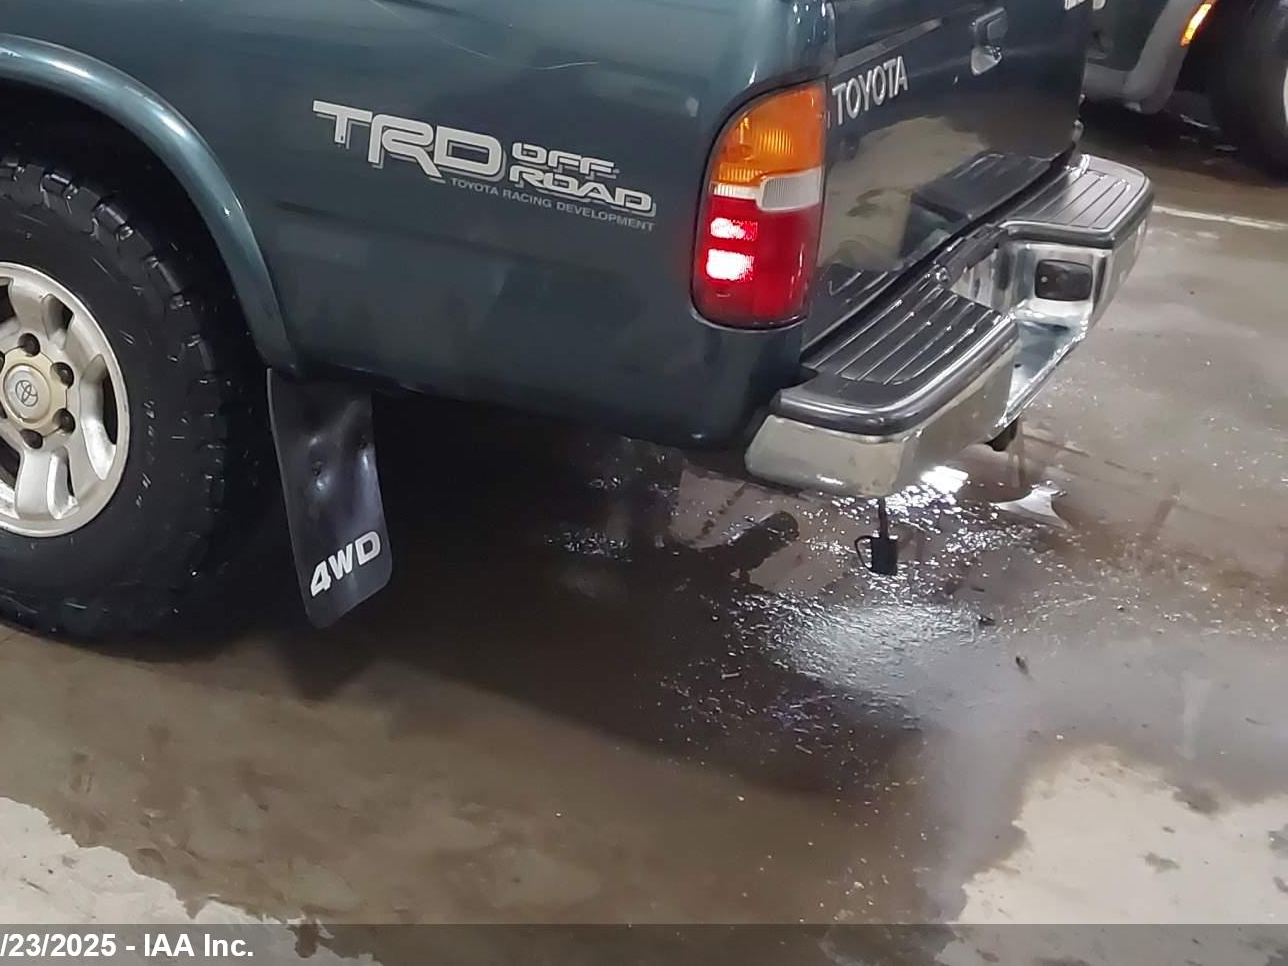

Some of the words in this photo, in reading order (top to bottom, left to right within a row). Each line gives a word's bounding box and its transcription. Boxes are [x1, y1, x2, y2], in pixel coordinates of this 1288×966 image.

[832, 55, 909, 125] TOYOTA
[312, 99, 504, 182] TRD
[512, 142, 620, 179] OFF
[451, 176, 500, 197] TOYOTA
[502, 188, 553, 209] RACING
[556, 200, 657, 232] DEVELOPMENT
[509, 165, 657, 217] ROAD
[310, 531, 381, 597] 4WD
